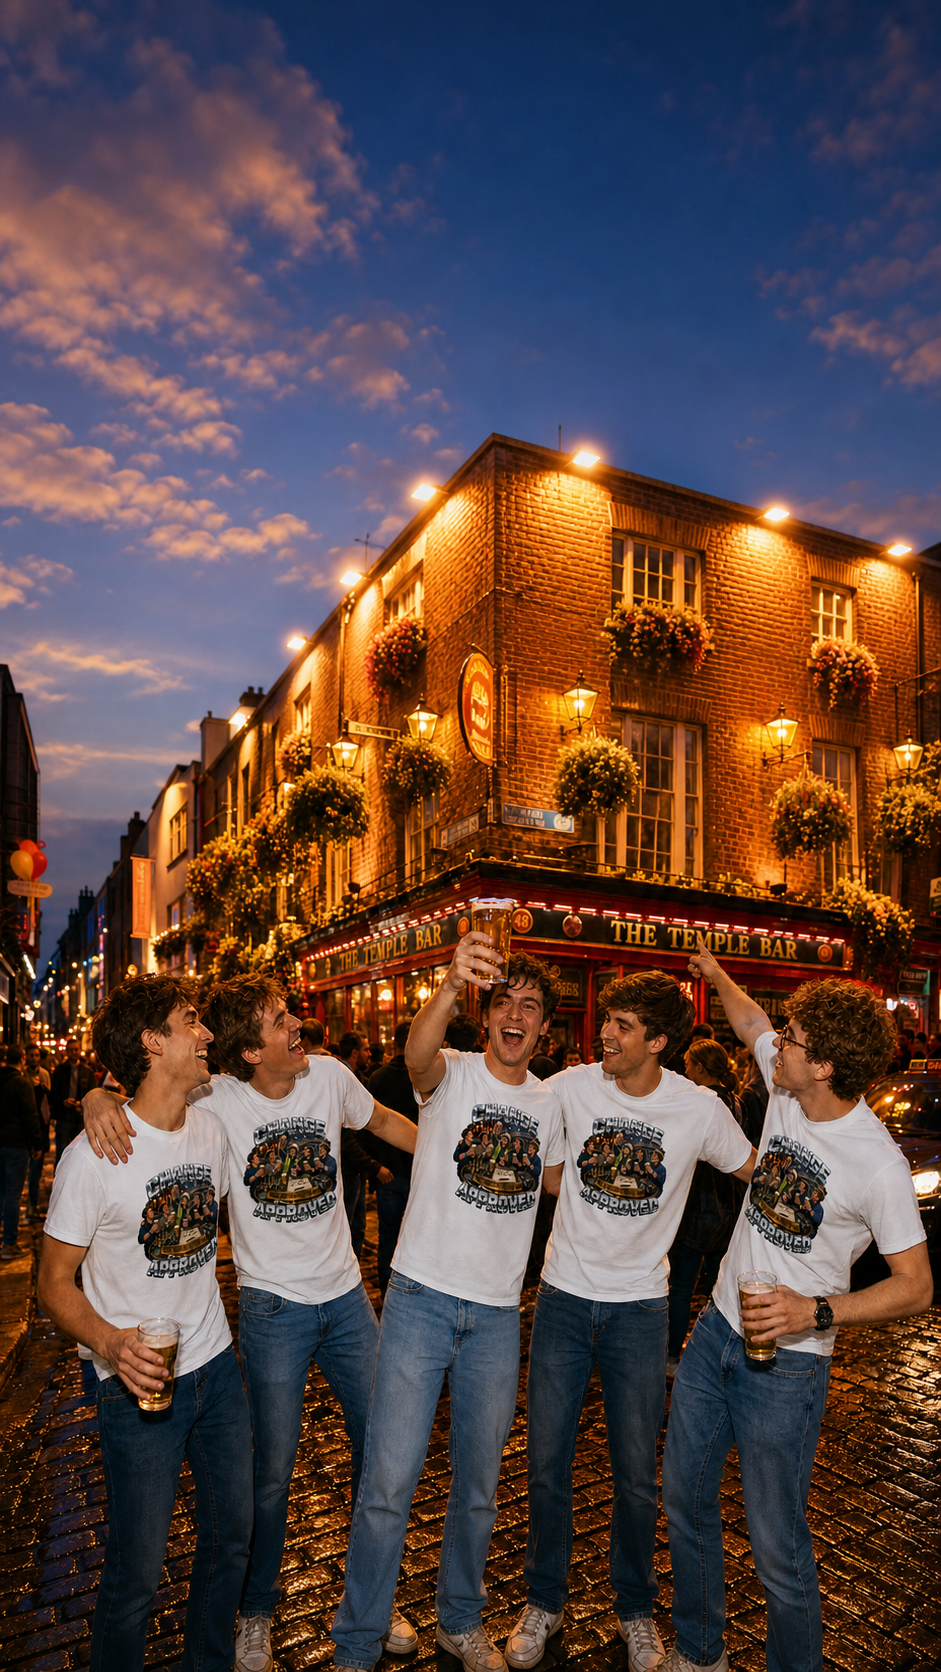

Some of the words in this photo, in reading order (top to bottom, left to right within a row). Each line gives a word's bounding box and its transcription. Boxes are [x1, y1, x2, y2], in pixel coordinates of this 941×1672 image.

[339, 950, 359, 971] THE
[363, 934, 408, 966] TEMPLE
[415, 924, 442, 949] BAR
[610, 919, 657, 946] THE
[667, 926, 750, 955] TEMPLE
[760, 937, 798, 960] BAR
